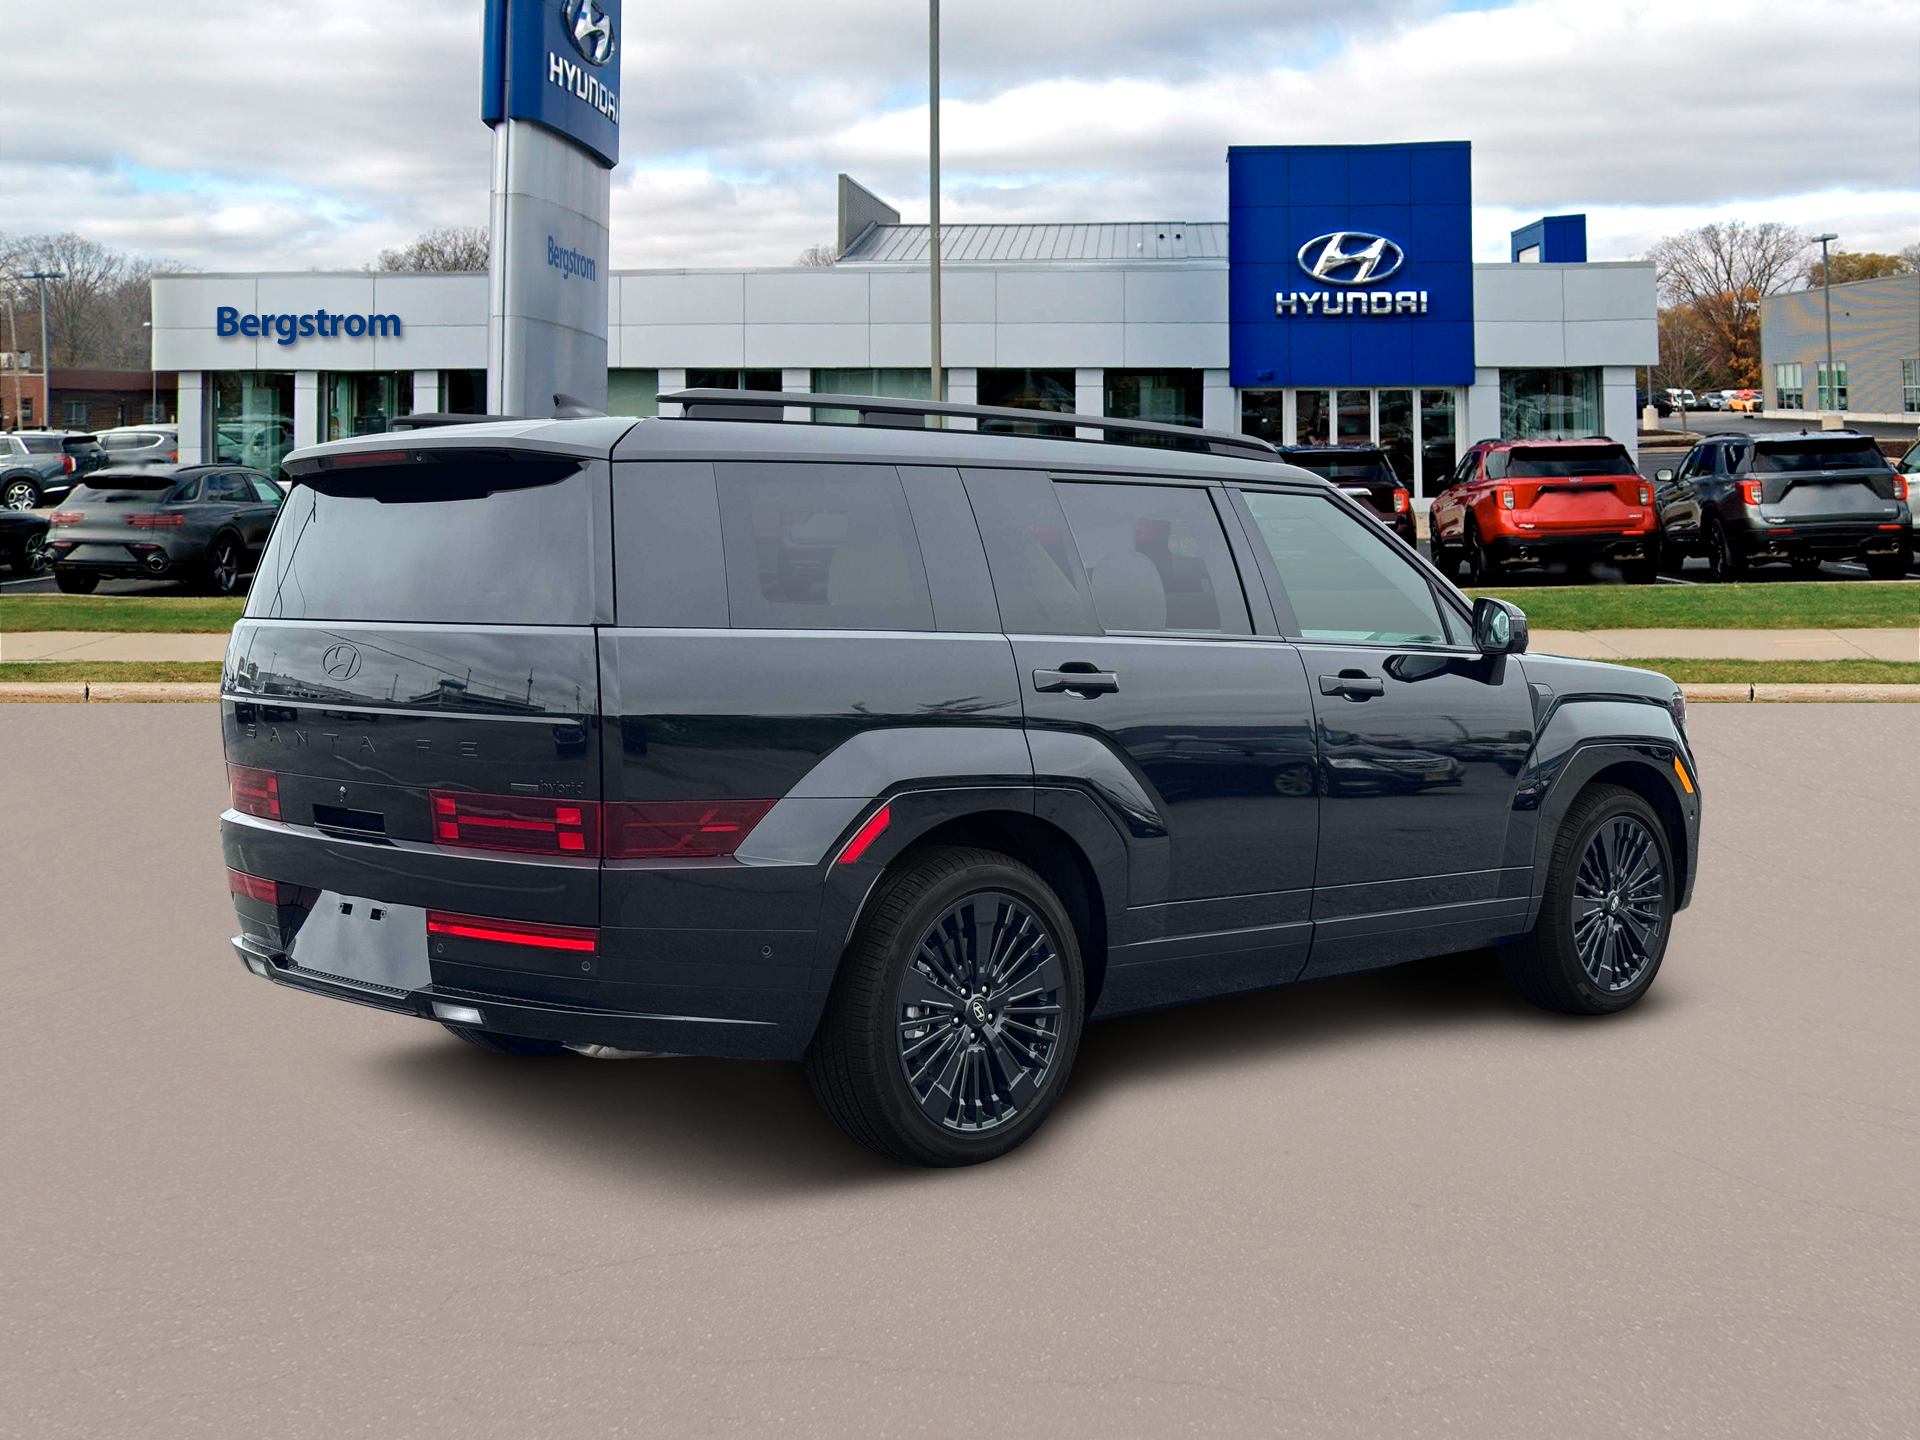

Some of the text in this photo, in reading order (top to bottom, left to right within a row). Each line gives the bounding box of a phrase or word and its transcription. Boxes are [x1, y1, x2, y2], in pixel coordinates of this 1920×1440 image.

[548, 51, 619, 125] HYUNDAI
[547, 234, 596, 282] Bergstrom
[1275, 290, 1428, 315] HYUNDAI
[216, 306, 401, 346] Bergstrom
[246, 723, 478, 757] SANTA FE
